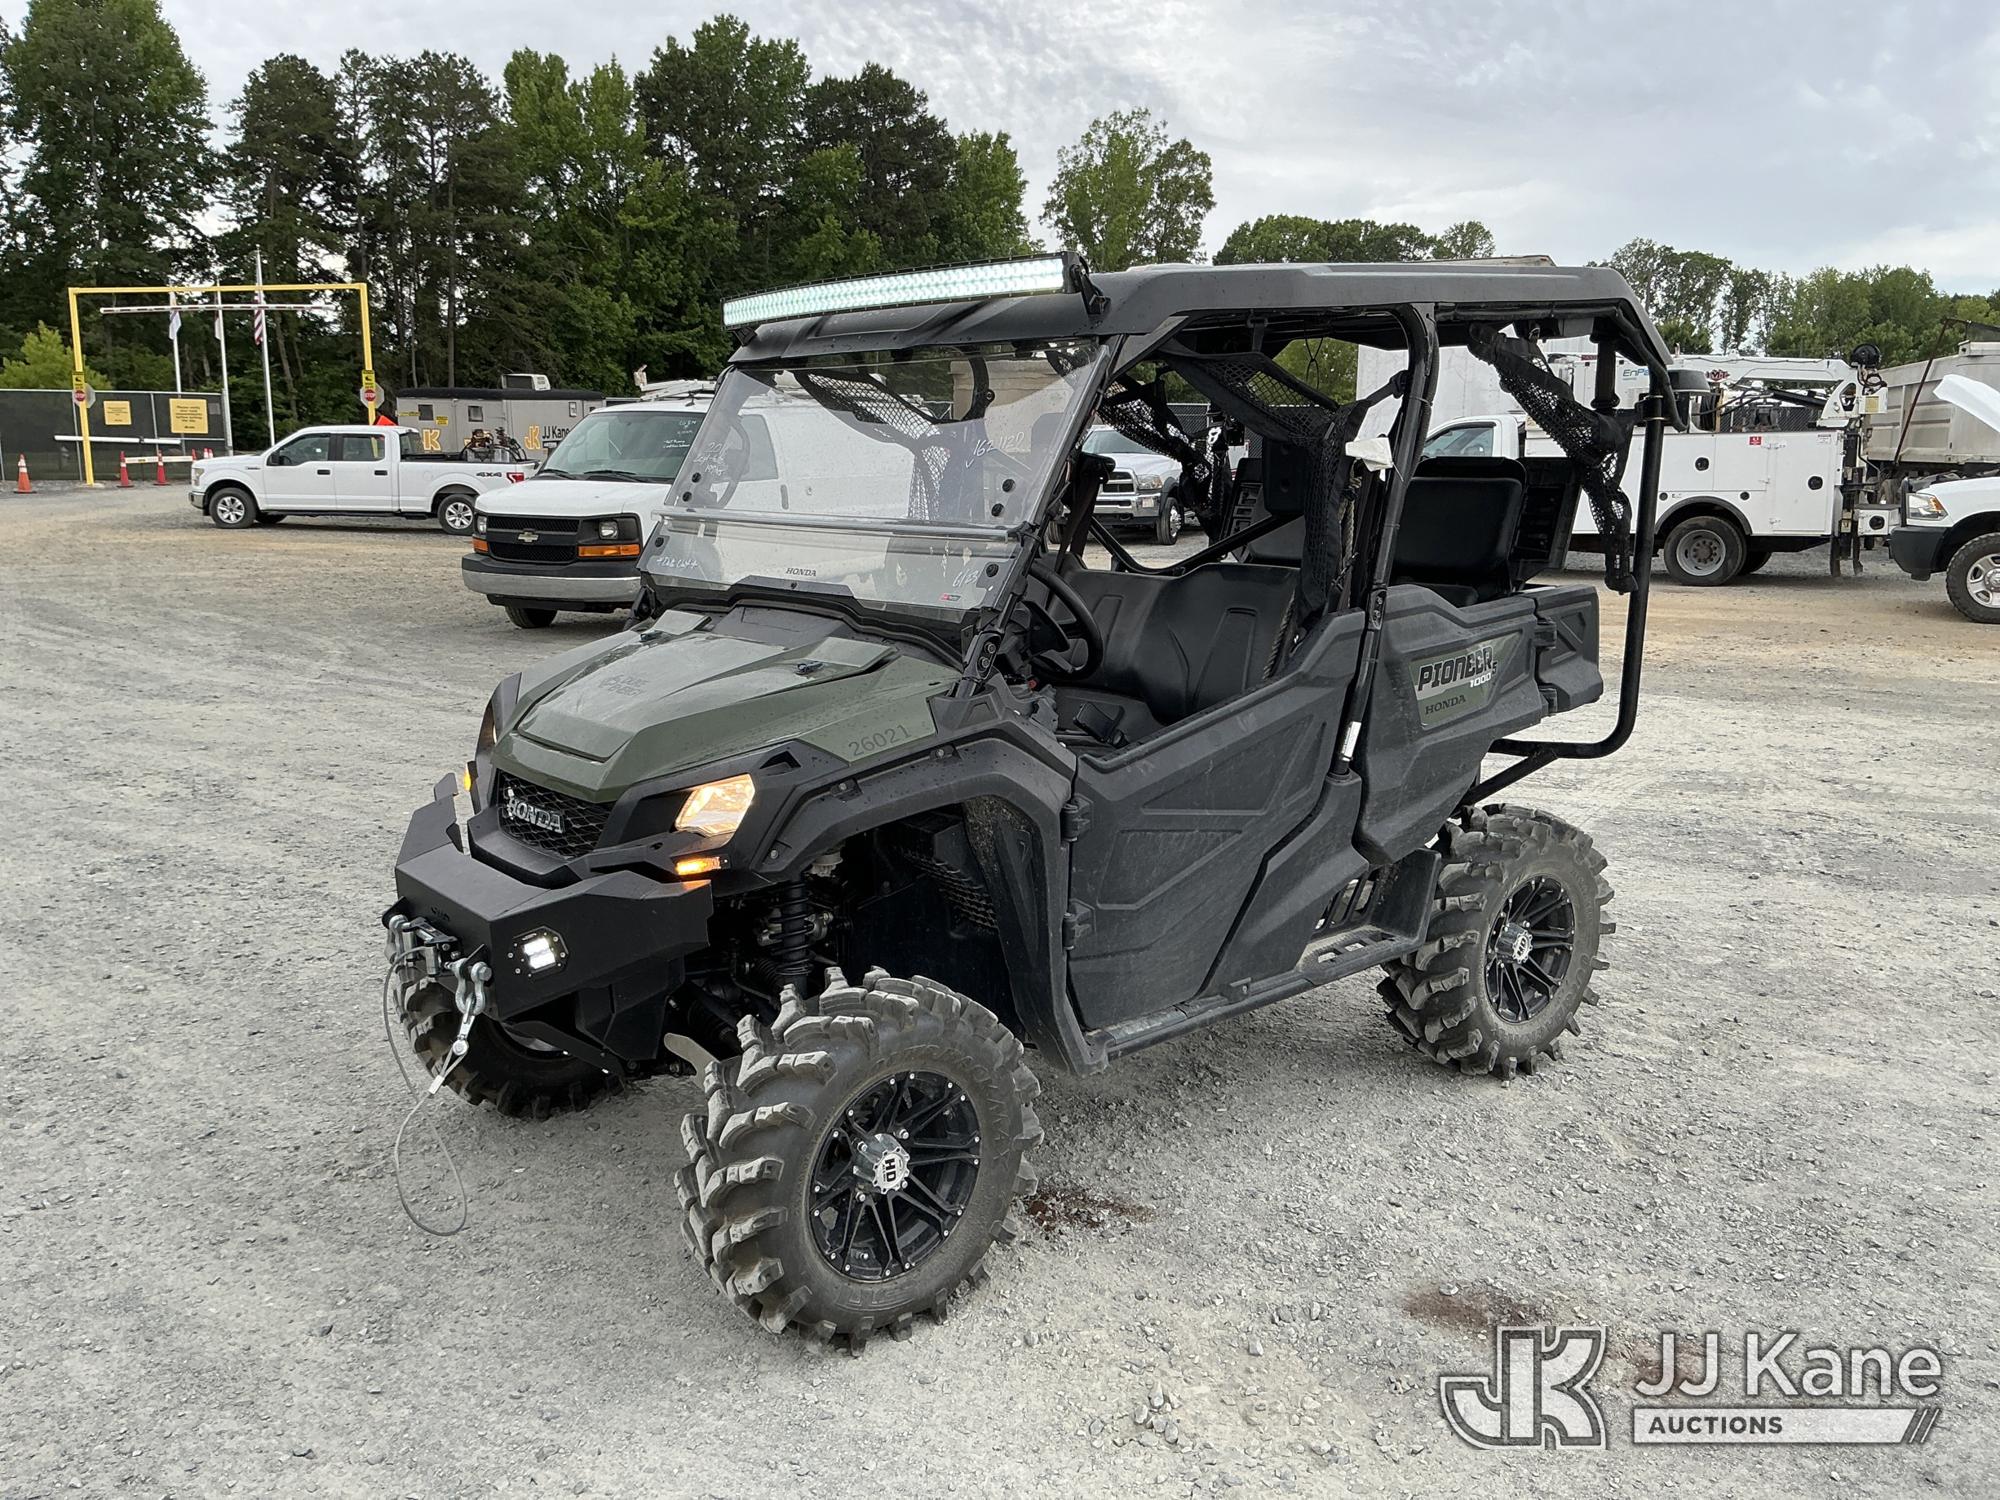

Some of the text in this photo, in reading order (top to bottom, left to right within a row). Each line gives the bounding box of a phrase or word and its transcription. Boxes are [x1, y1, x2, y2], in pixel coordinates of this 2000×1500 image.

[785, 567, 817, 577] HONDA
[1417, 646, 1494, 692] PIONEER
[1470, 672, 1492, 688] 1000
[1425, 694, 1466, 714] HONDA
[848, 724, 912, 756] 26021
[506, 797, 563, 834] HONDA
[885, 1158, 896, 1183] HD
